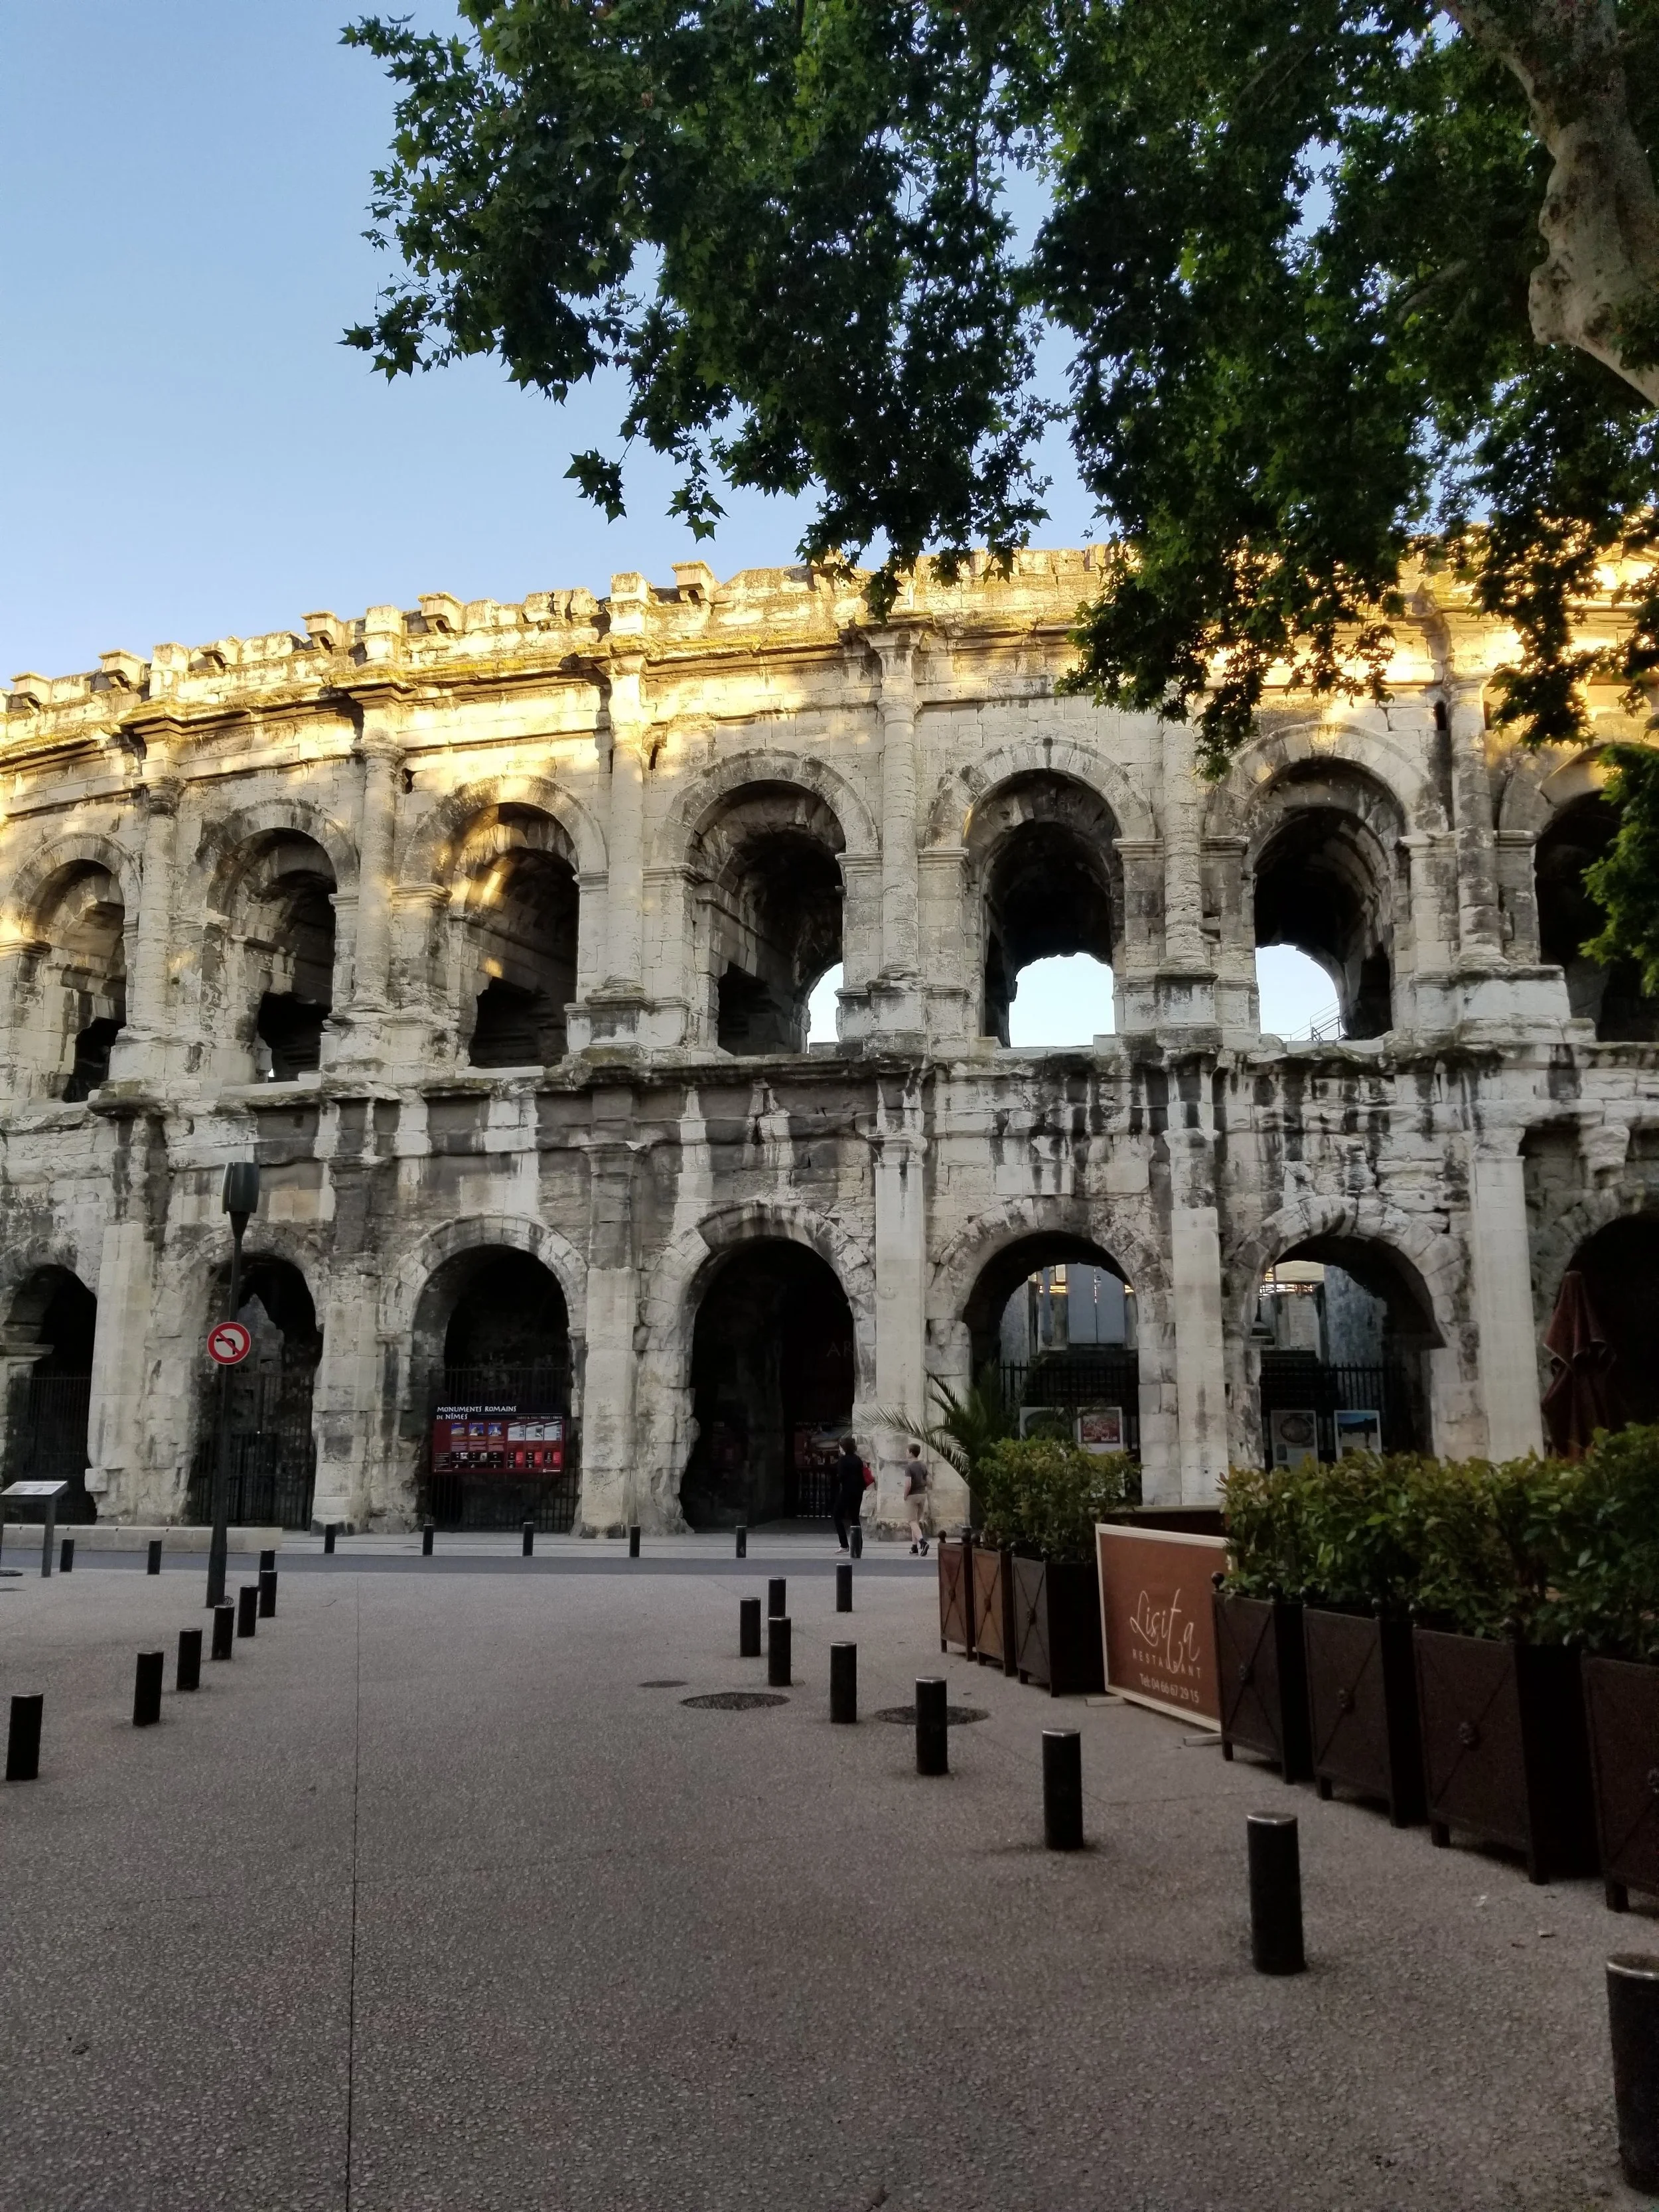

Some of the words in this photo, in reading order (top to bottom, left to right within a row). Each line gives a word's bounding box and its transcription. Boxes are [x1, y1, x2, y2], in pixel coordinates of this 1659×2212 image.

[1129, 1587, 1200, 1674] Lisita
[1132, 1648, 1200, 1678] RESTAURANT
[1151, 1677, 1159, 1690] 04
[1161, 1680, 1169, 1694] 66
[1170, 1684, 1177, 1696] 67
[1179, 1686, 1189, 1700] 29
[1190, 1689, 1198, 1703] 15
